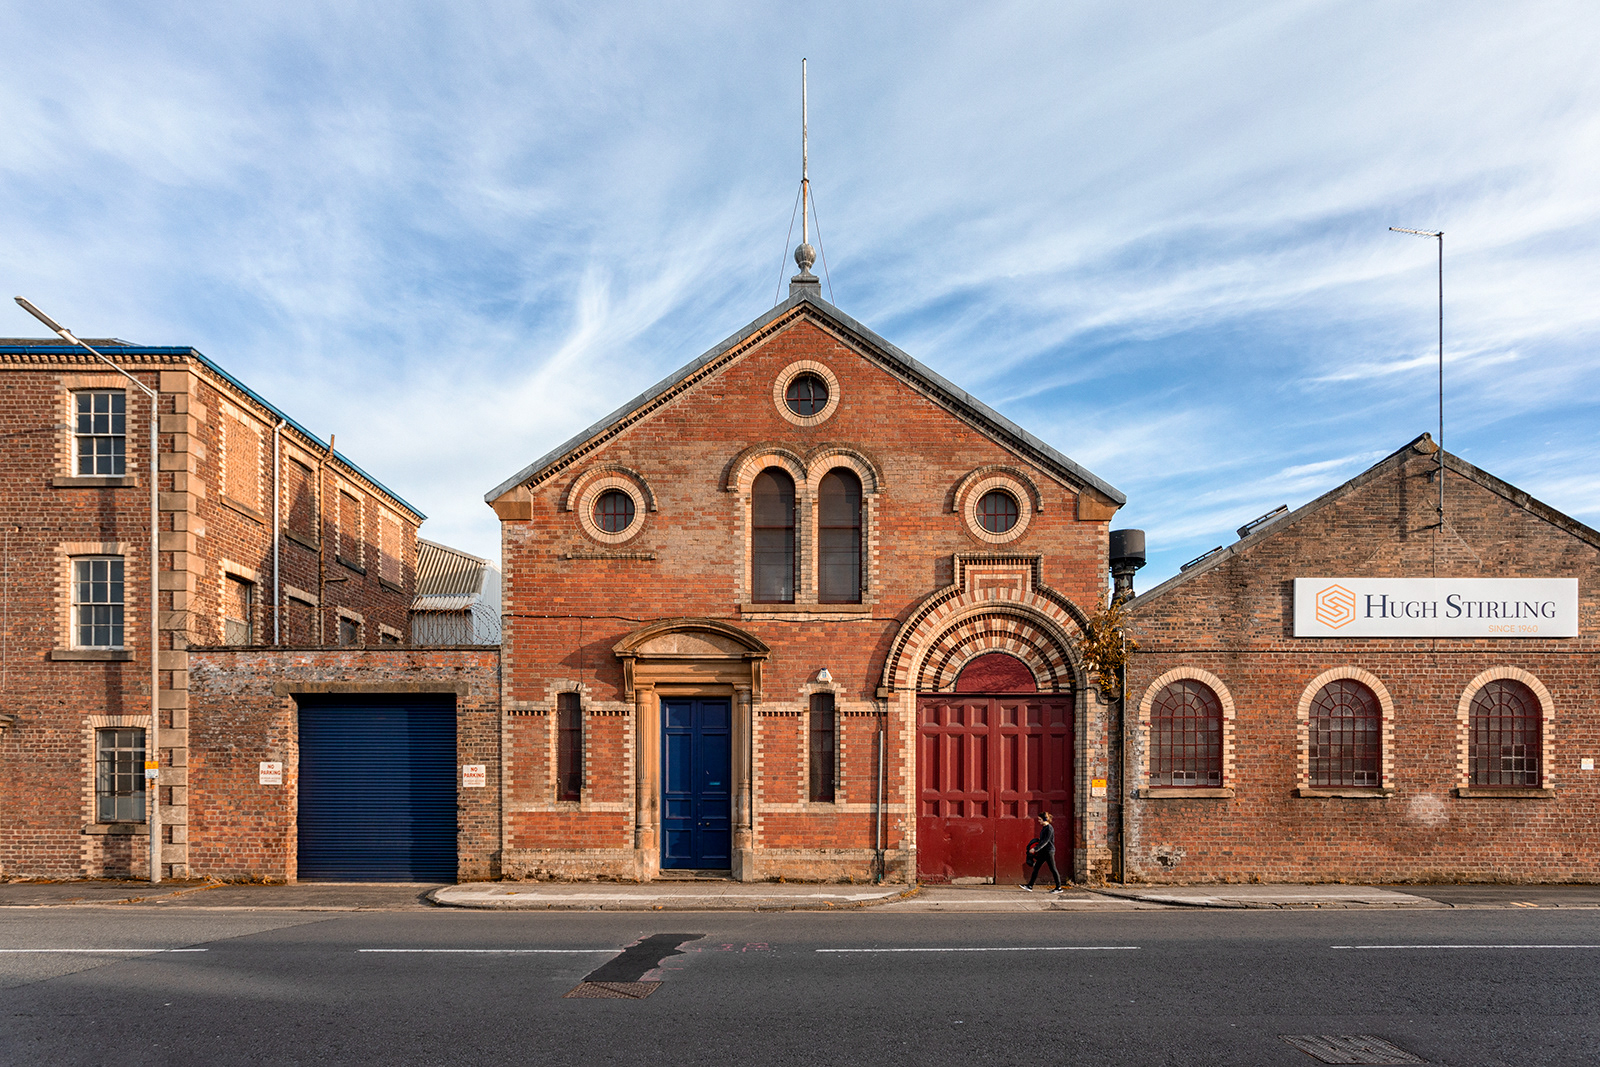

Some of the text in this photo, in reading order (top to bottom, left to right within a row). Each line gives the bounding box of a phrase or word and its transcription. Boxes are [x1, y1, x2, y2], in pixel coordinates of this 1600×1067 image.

[1364, 593, 1557, 619] HUGH STIRLING
[1488, 624, 1538, 633] SINCE 1960
